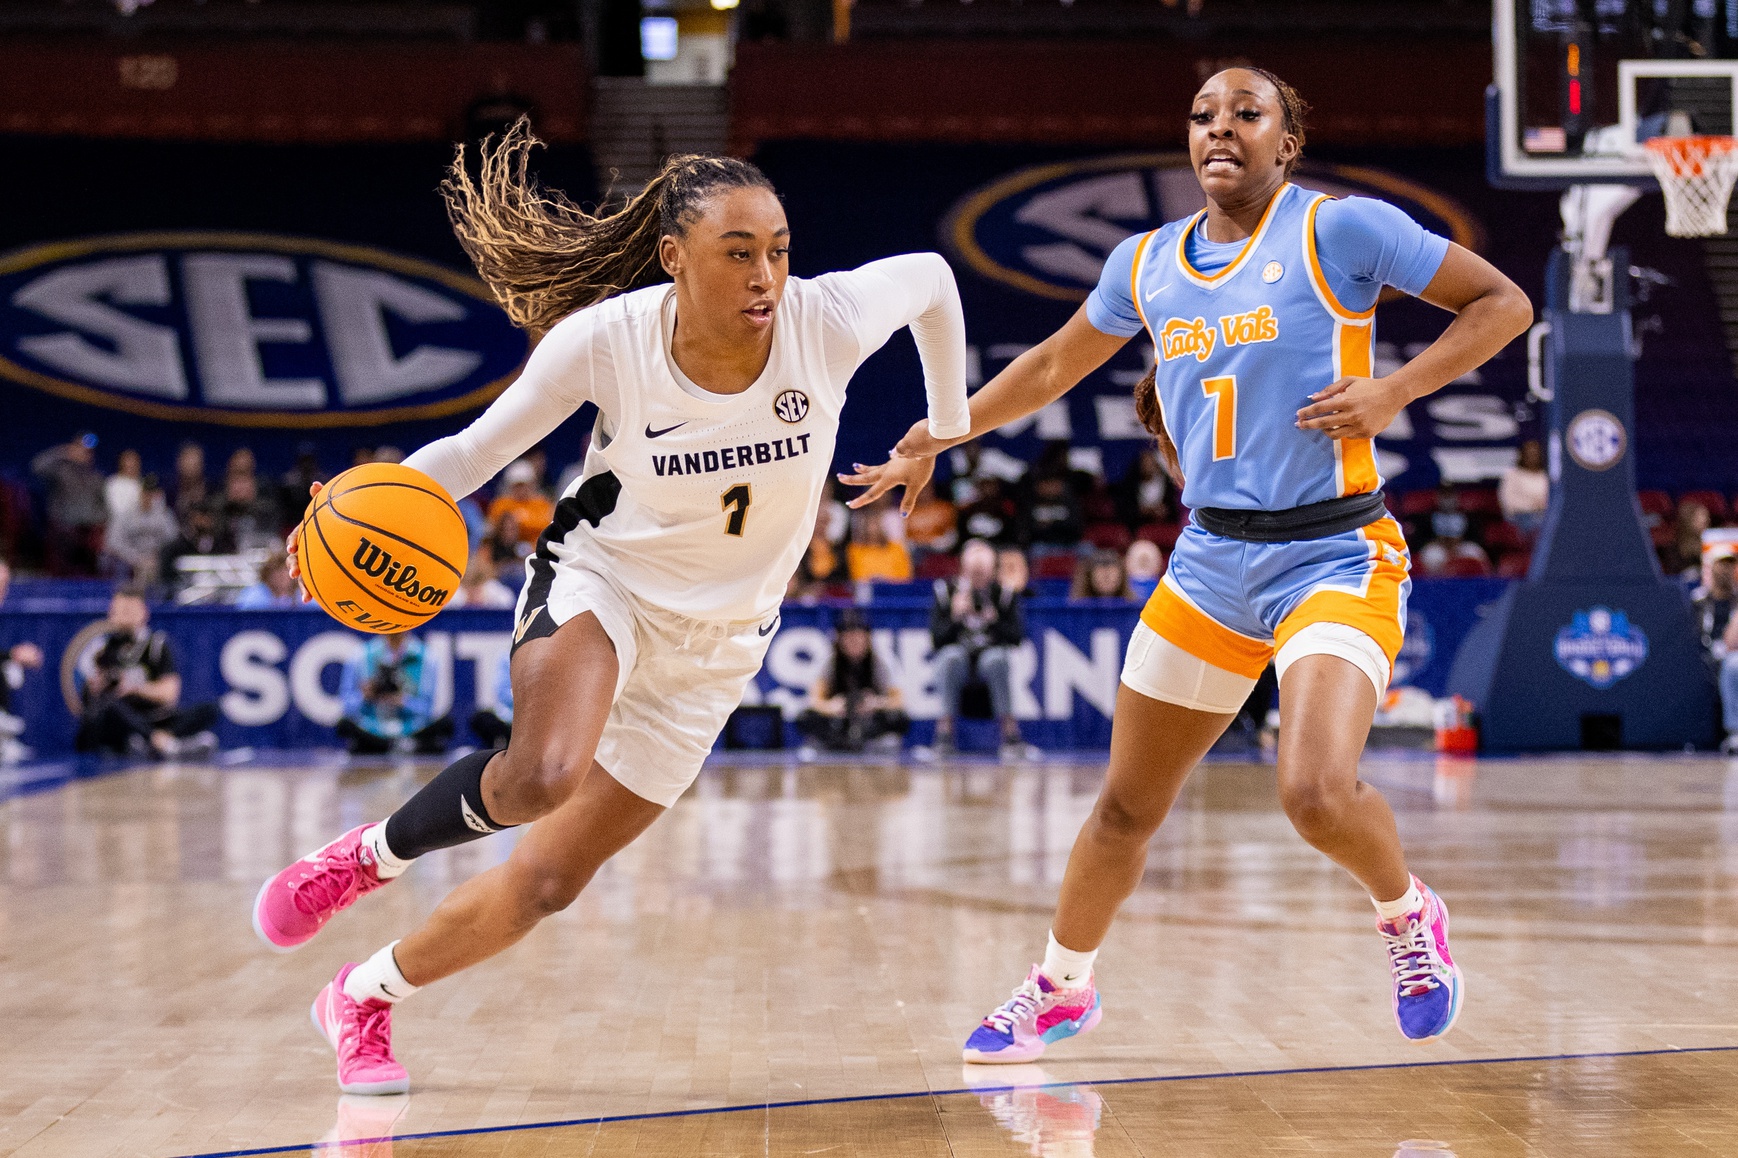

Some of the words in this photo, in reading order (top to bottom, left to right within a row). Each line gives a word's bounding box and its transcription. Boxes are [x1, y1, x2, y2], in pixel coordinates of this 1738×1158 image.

[11, 253, 485, 406] SEC
[1160, 317, 1217, 362] Lady
[1218, 305, 1279, 347] Vols
[775, 391, 808, 422] SEC
[1200, 375, 1238, 462] 1
[652, 433, 811, 476] VANDERBILT
[720, 482, 752, 538] 1
[353, 537, 448, 607] Wilson
